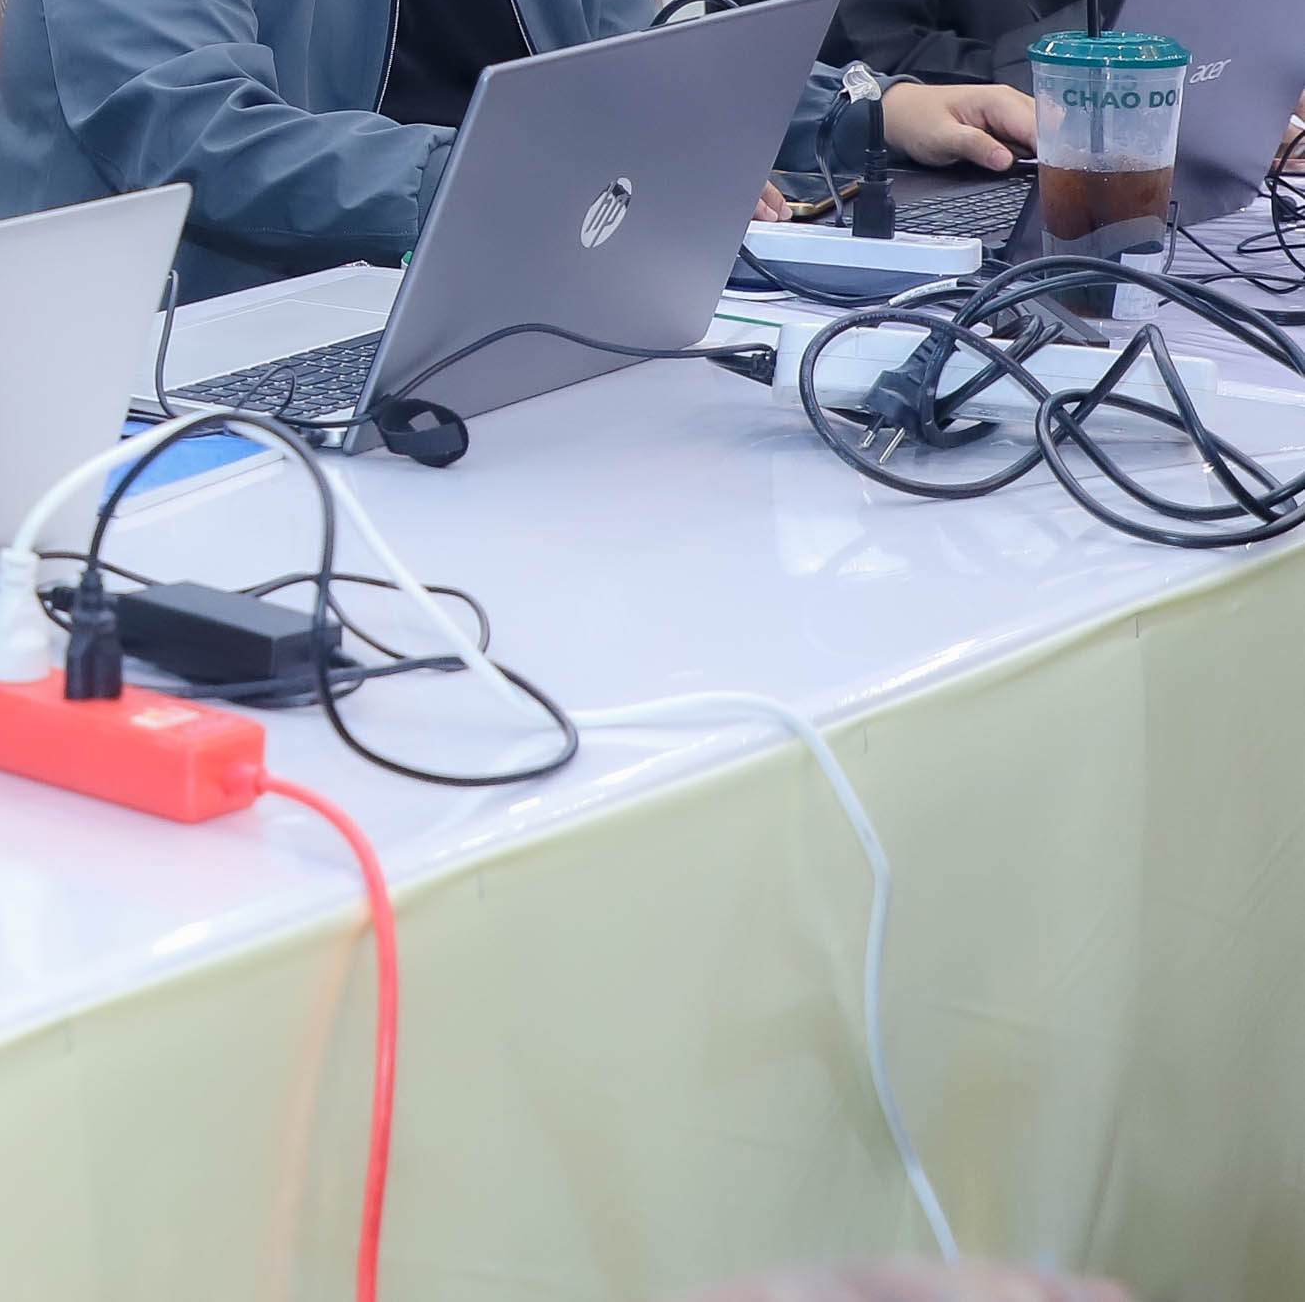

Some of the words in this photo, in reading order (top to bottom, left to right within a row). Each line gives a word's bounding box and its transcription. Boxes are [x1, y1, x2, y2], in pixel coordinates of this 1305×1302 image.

[1189, 59, 1232, 84] acer
[1062, 89, 1141, 109] CHAO
[583, 181, 629, 248] hp
